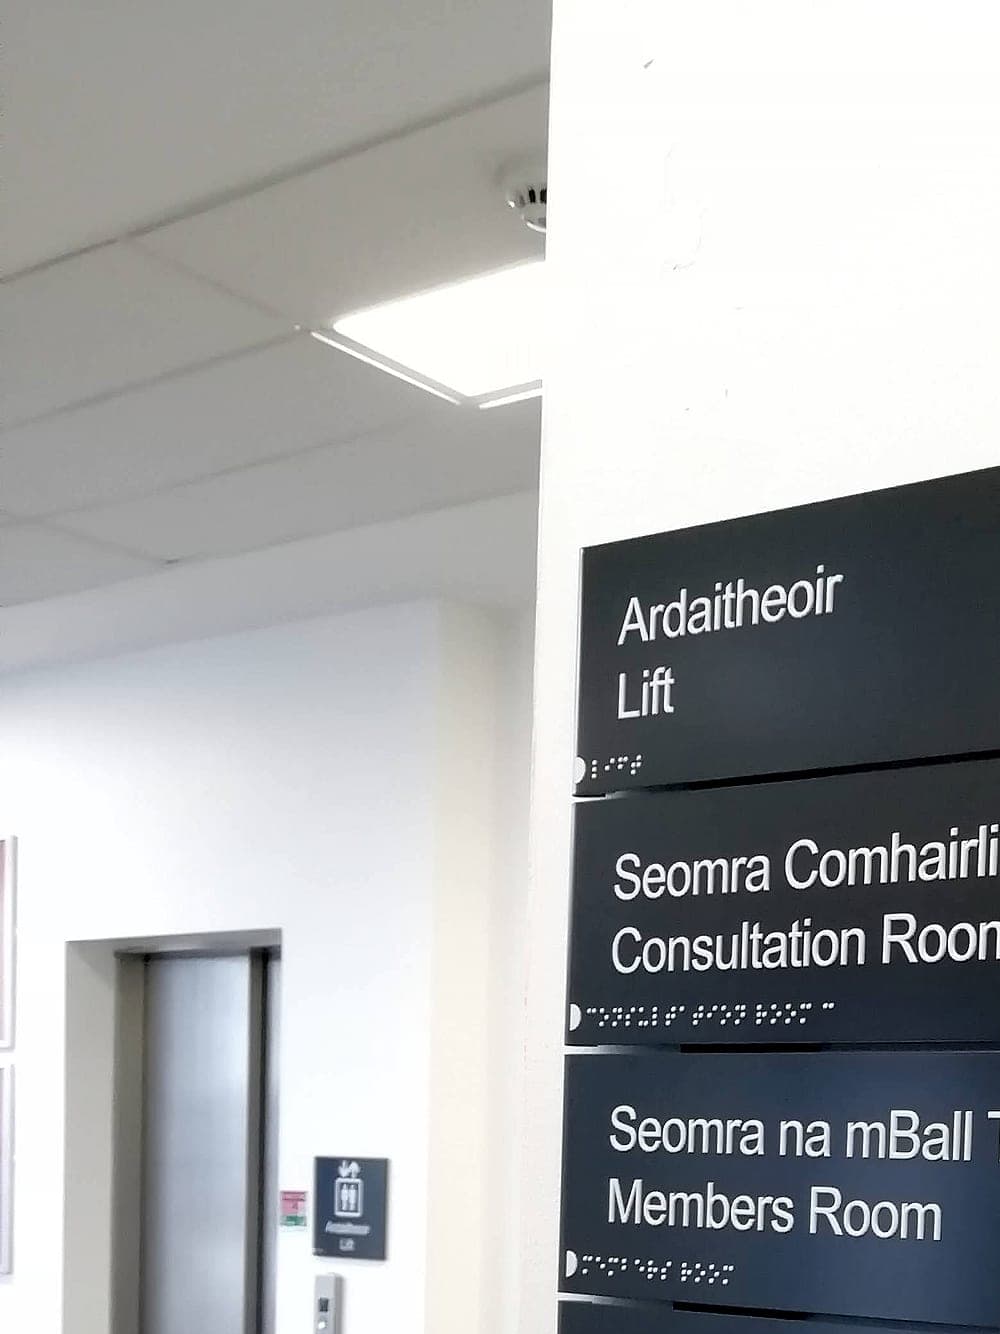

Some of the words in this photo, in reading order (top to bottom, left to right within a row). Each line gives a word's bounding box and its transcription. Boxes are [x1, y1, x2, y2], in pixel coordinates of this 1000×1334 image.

[618, 565, 841, 643] Ardaitheoir
[618, 666, 676, 719] Lift
[613, 853, 769, 900] Seomra
[612, 918, 866, 973] Consultation
[610, 1105, 764, 1156] Seomra
[779, 1121, 831, 1157] na
[846, 1109, 973, 1162] mBall
[608, 1178, 794, 1234] Members
[810, 1186, 942, 1241] Room
